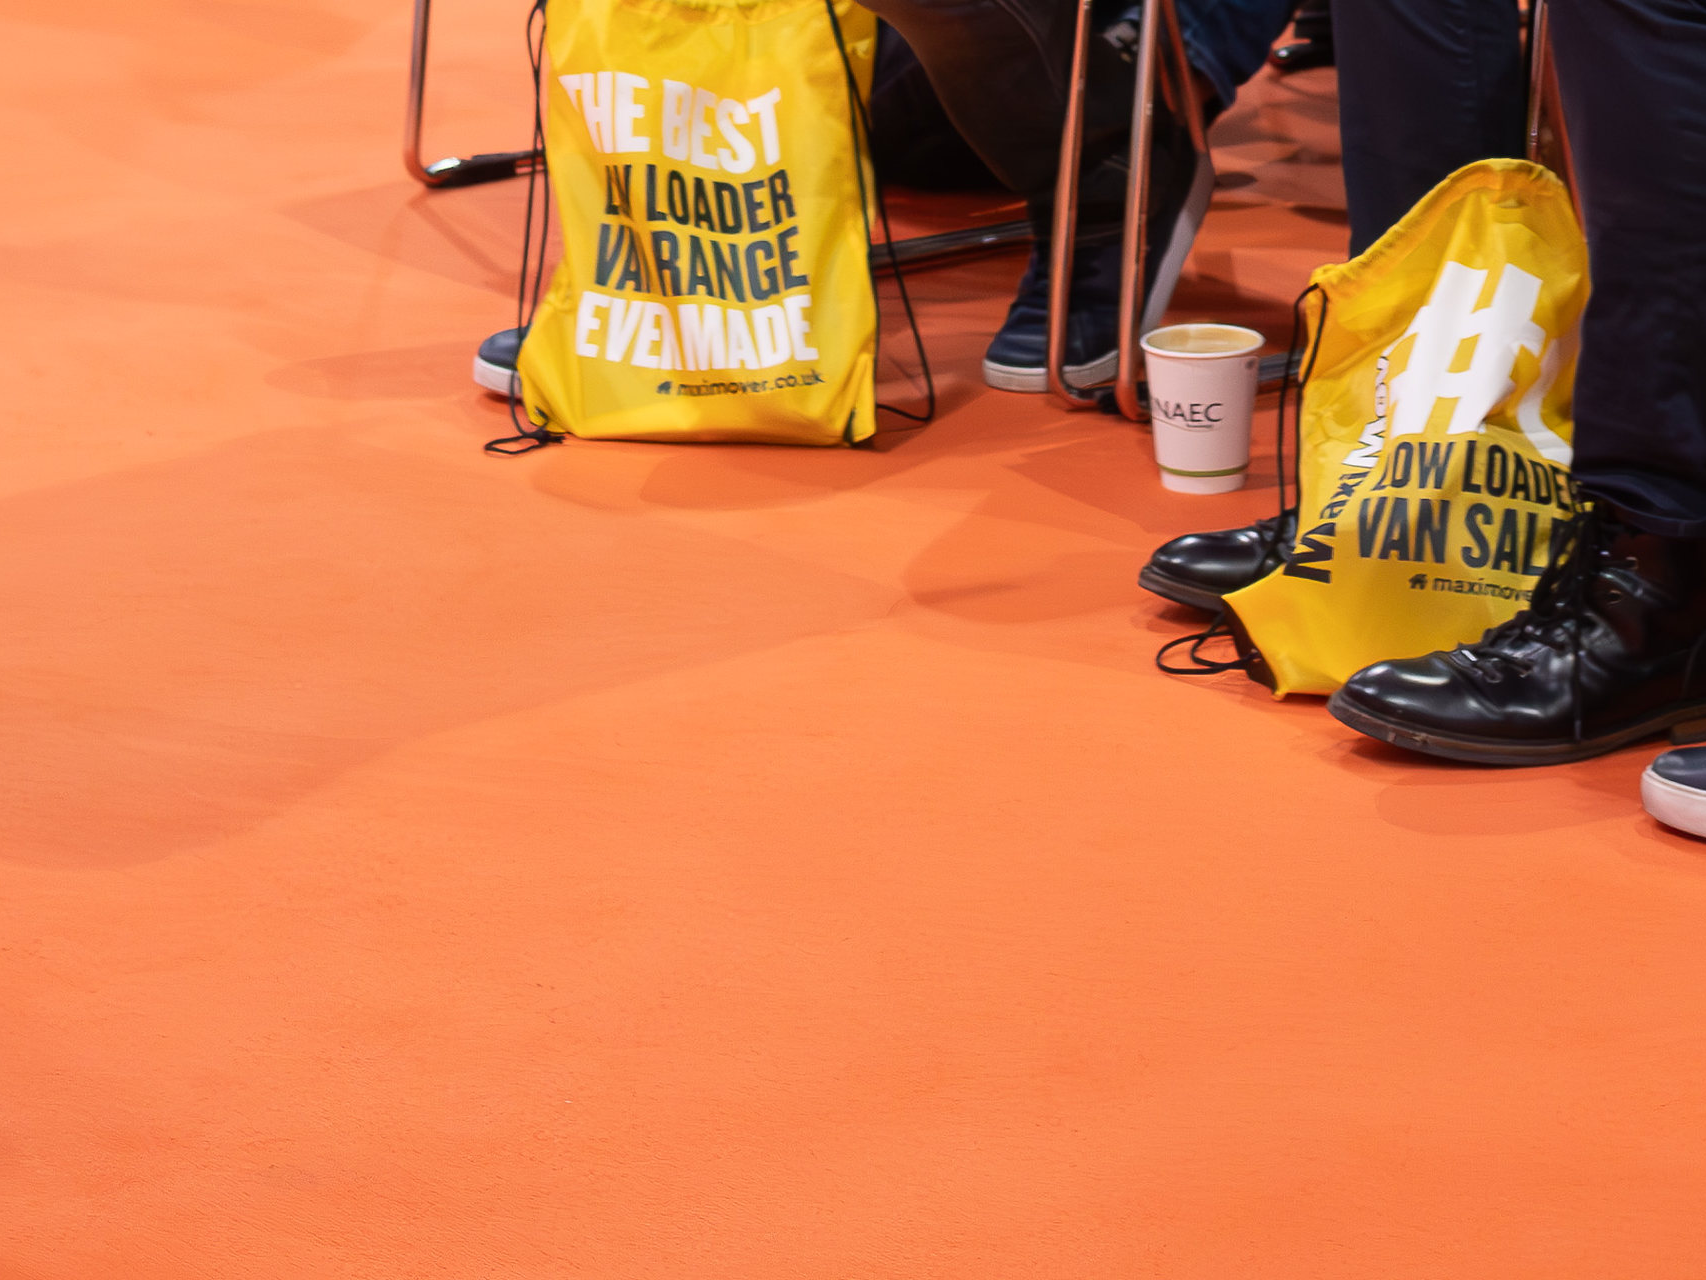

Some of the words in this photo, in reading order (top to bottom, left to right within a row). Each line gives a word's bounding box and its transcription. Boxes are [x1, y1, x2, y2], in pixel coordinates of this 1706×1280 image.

[662, 79, 781, 174] BEST
[646, 164, 797, 235] LOADER
[677, 294, 819, 371] MADE
[1371, 440, 1457, 491] LOW
[1358, 496, 1450, 564] VAN
